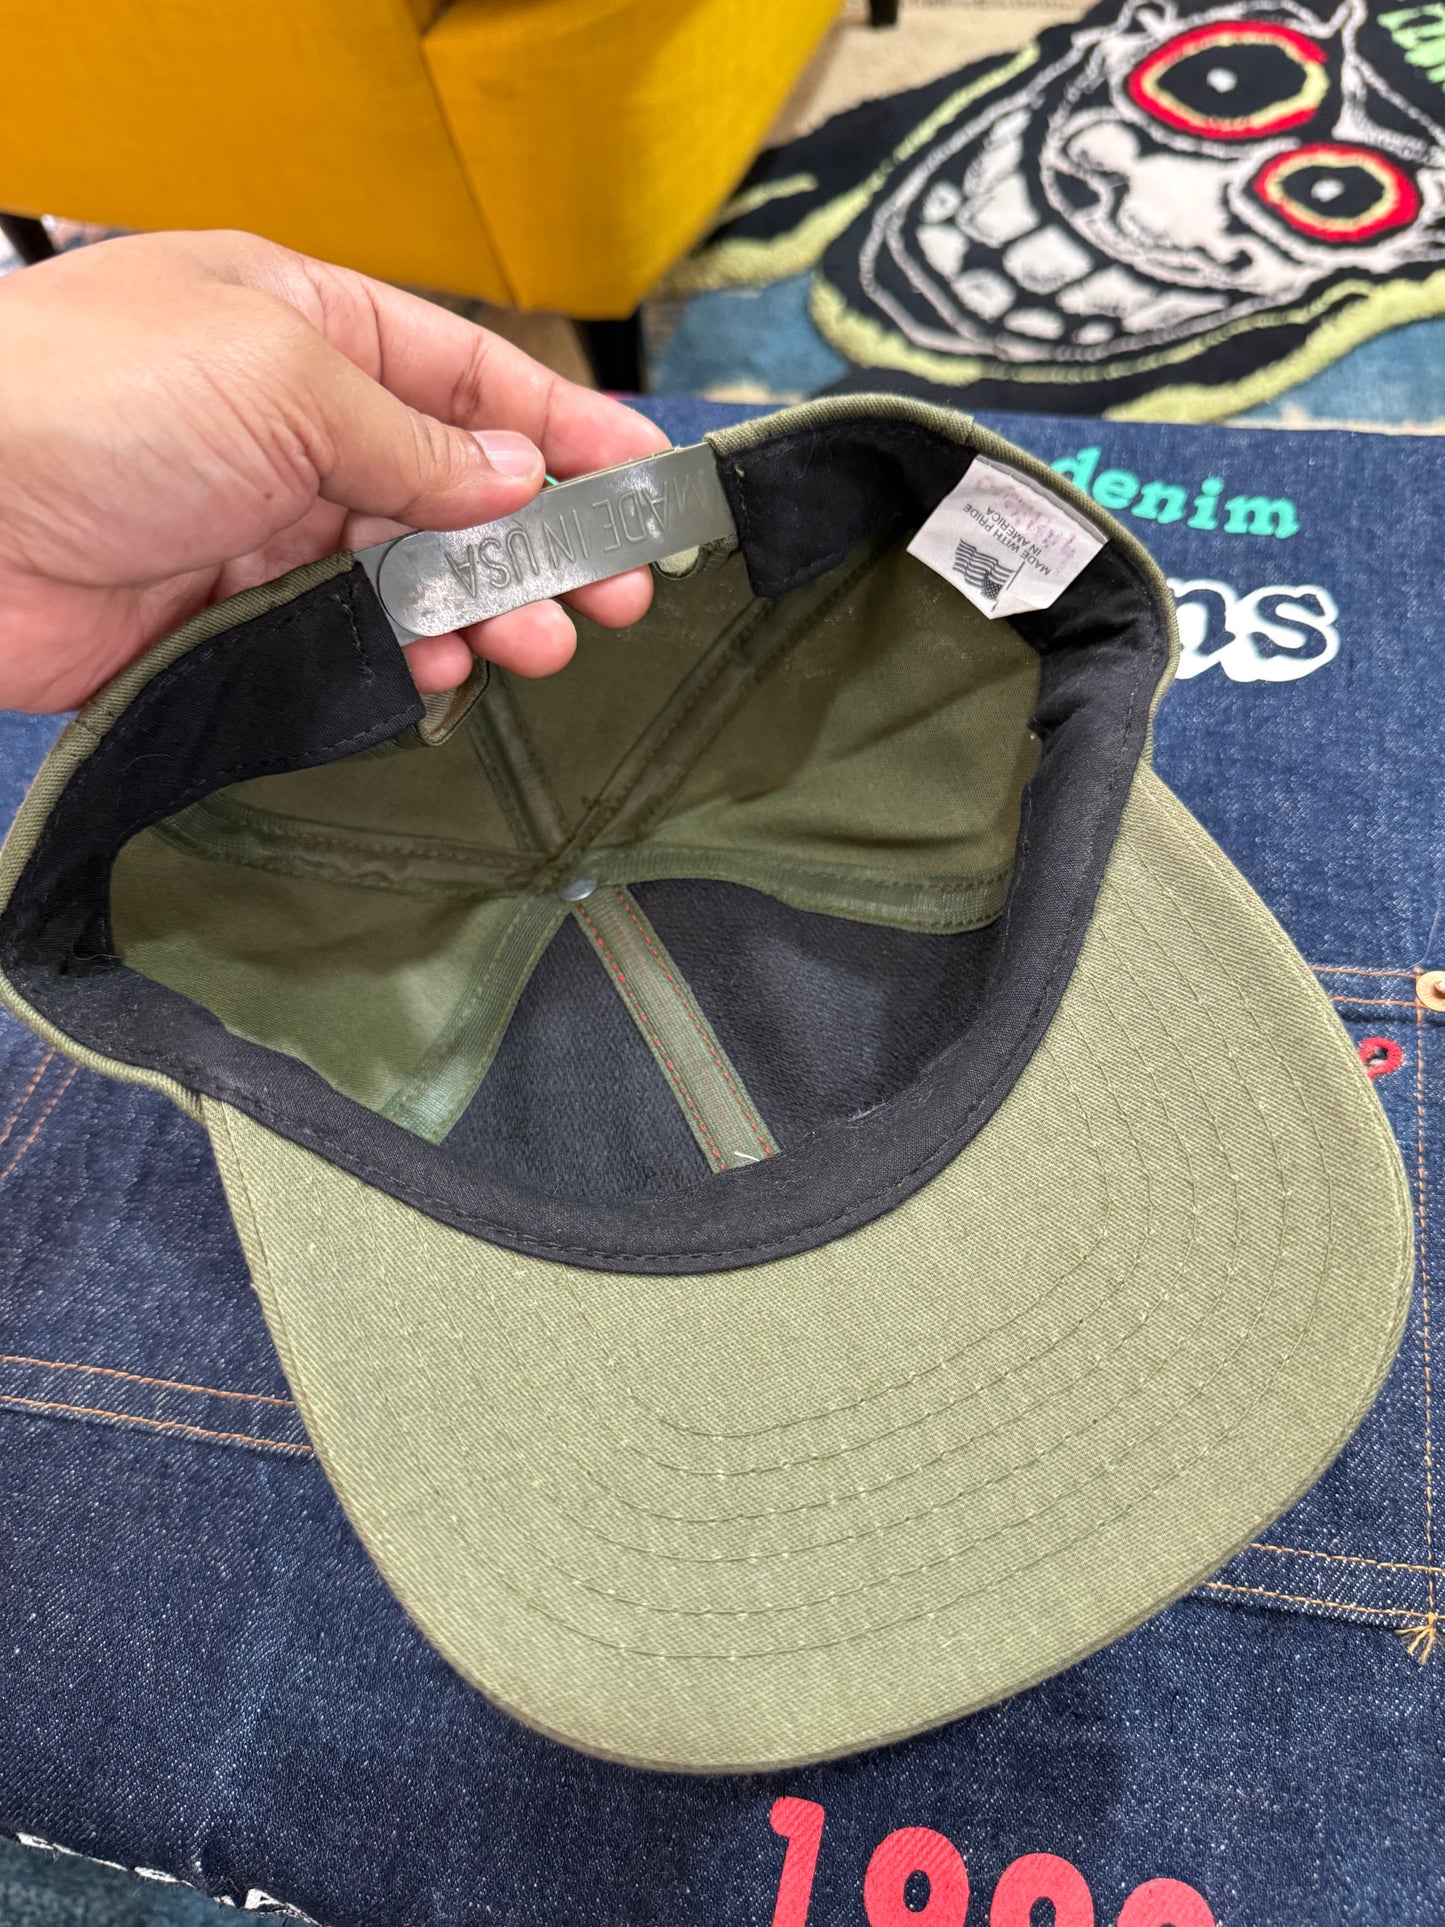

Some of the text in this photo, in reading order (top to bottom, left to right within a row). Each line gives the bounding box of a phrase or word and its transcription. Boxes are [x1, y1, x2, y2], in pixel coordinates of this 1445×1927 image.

[446, 470, 706, 598] MADE IN USA
[986, 506, 1043, 557] IN AMERICA
[1050, 446, 1300, 539] denim
[962, 502, 1052, 577] MADE WITH PRIDE
